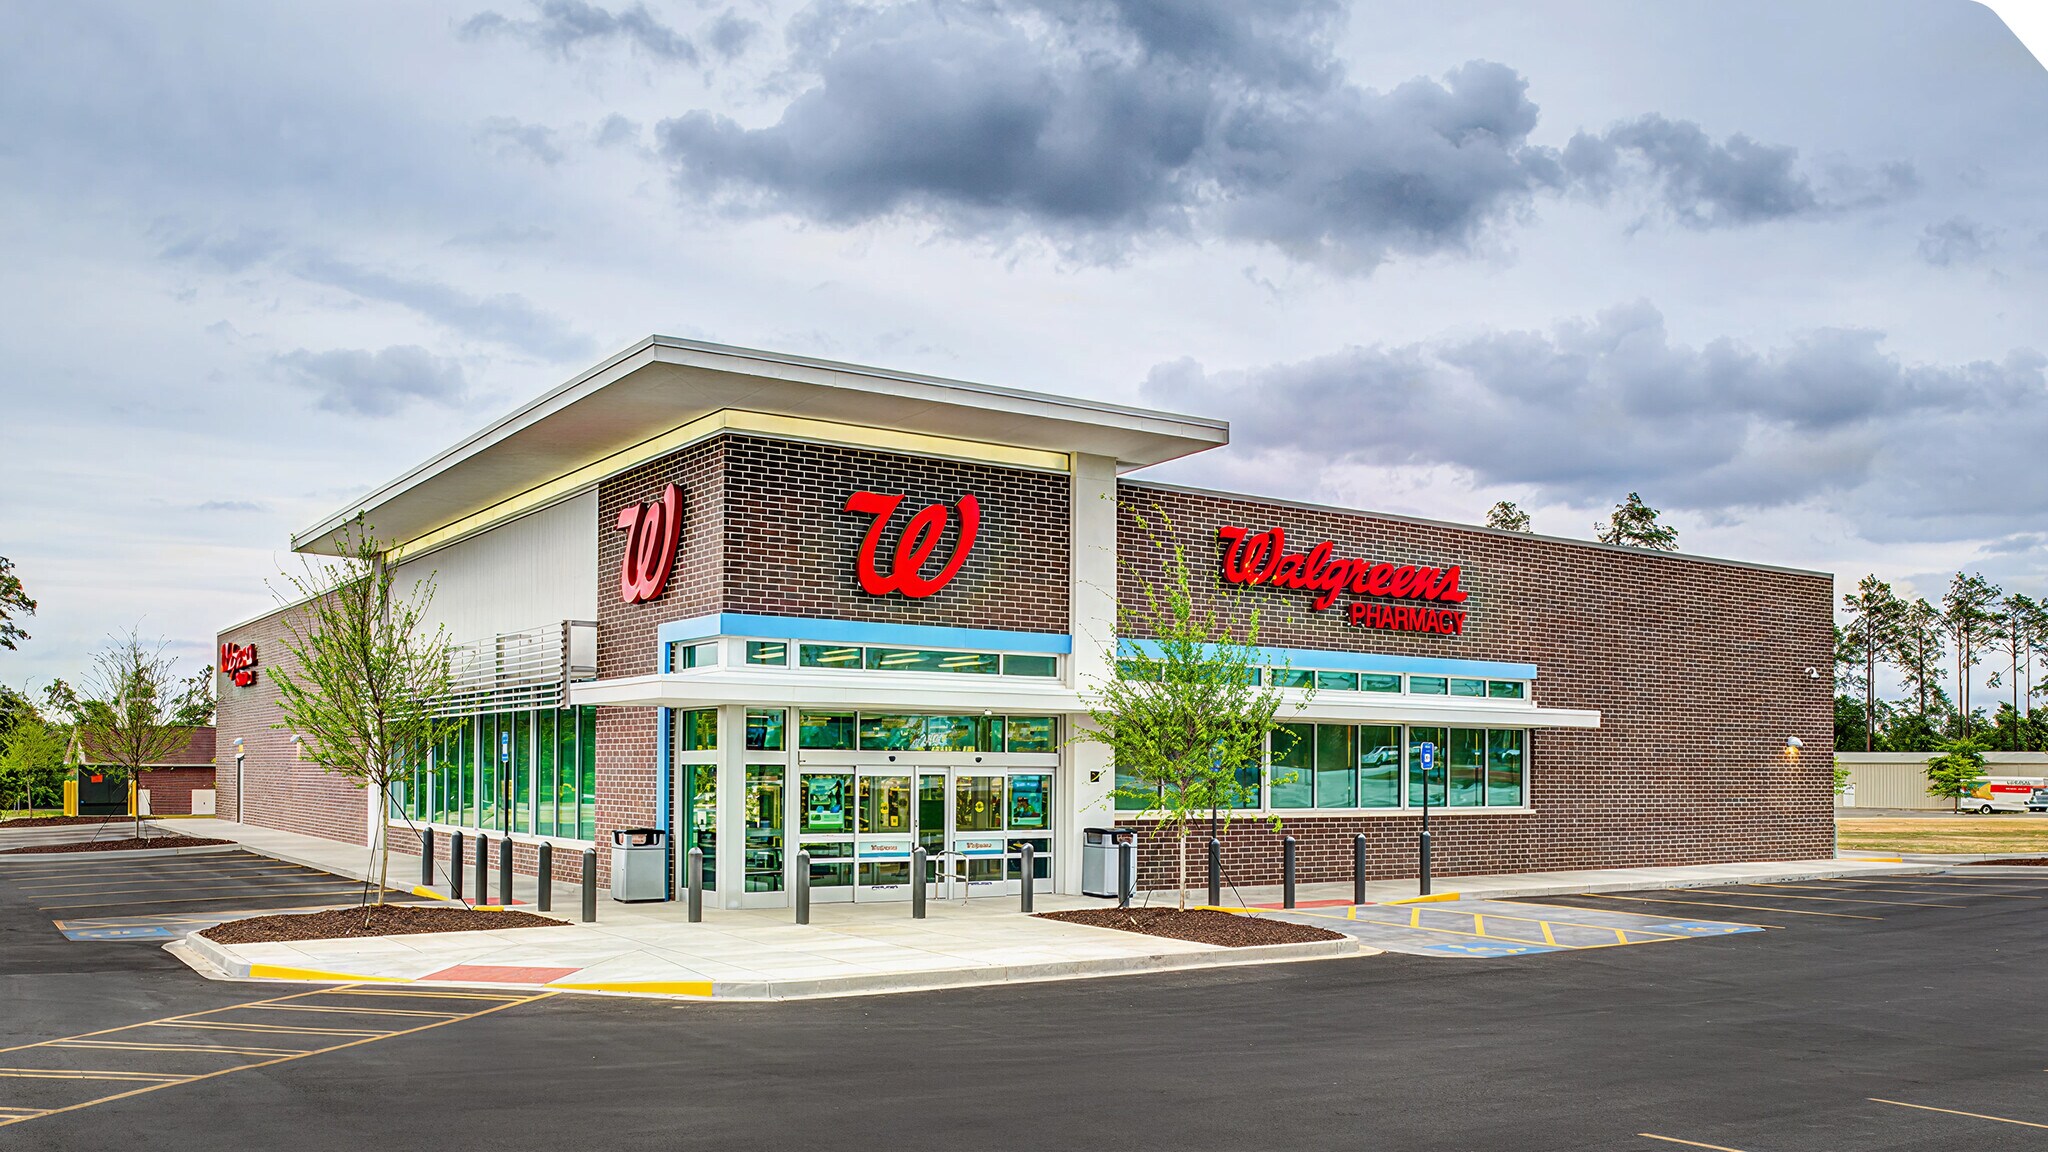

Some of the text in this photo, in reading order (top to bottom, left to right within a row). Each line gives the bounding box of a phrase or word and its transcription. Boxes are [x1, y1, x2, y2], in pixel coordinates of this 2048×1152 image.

[616, 482, 684, 604] W
[843, 490, 980, 599] W
[1219, 525, 1468, 611] Walgreens
[1349, 602, 1466, 636] PHARMACY
